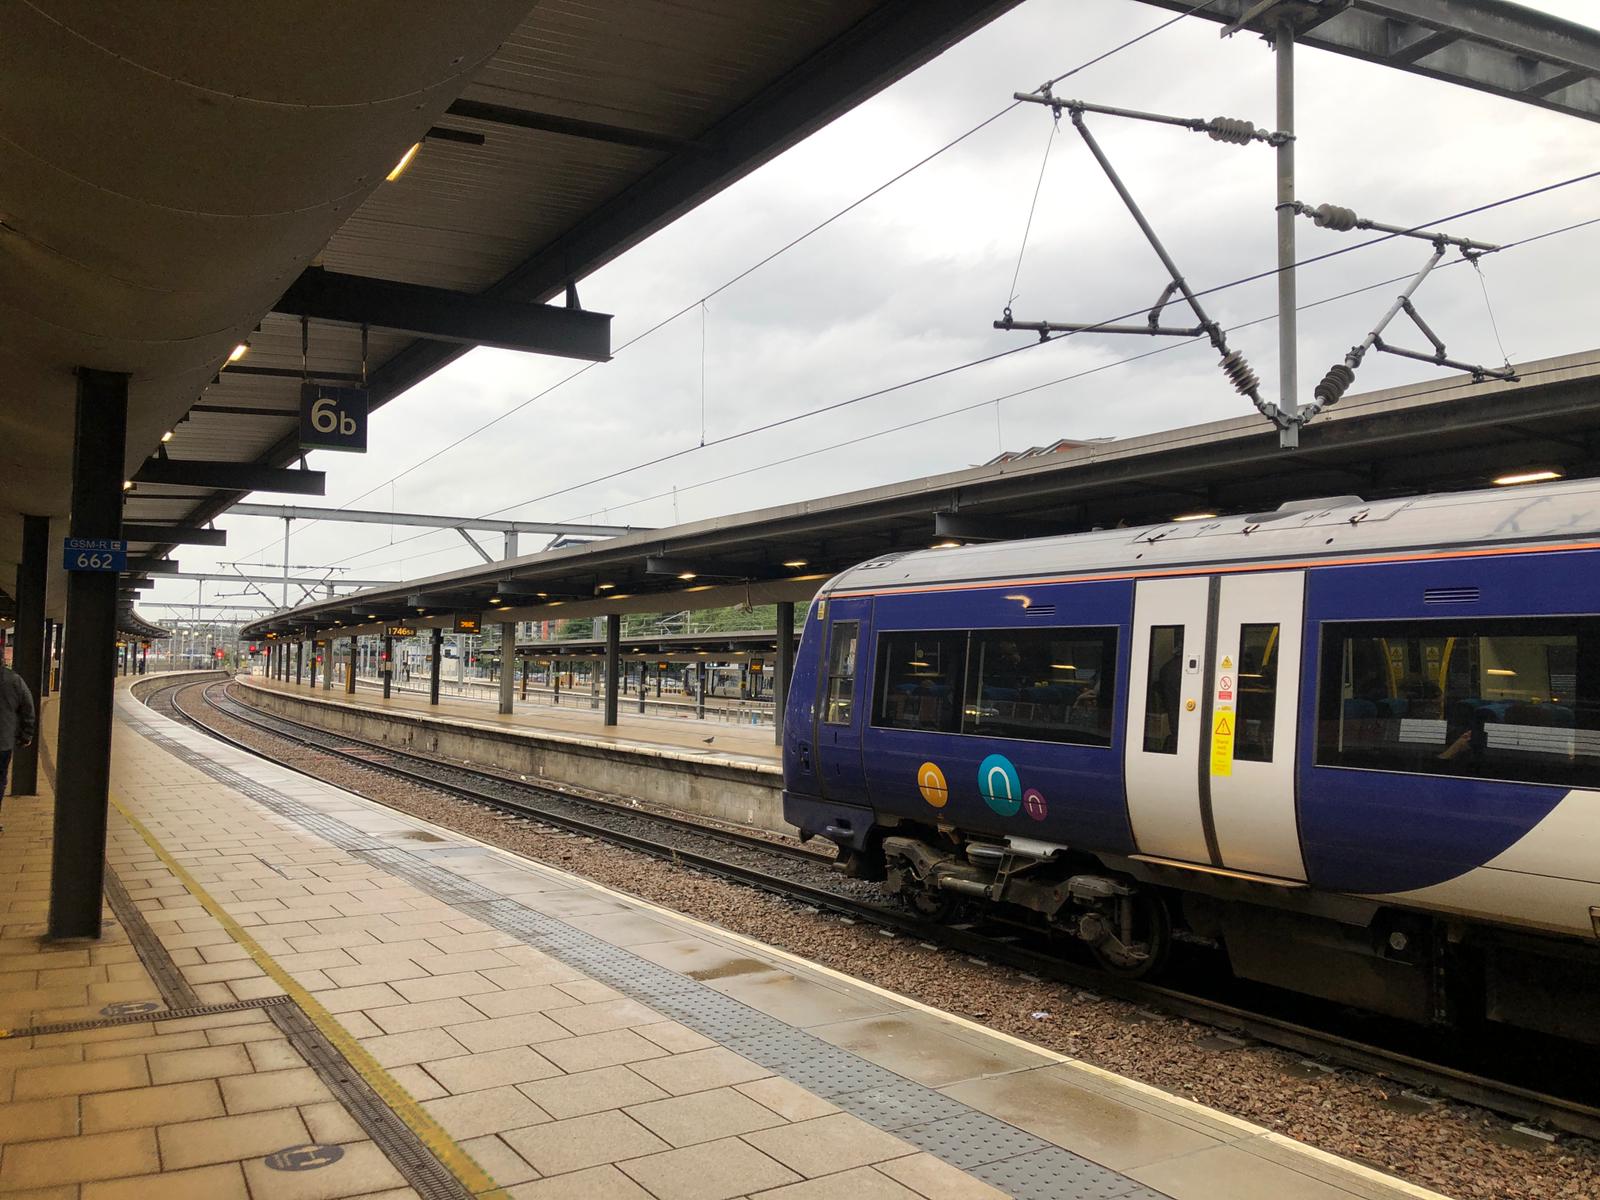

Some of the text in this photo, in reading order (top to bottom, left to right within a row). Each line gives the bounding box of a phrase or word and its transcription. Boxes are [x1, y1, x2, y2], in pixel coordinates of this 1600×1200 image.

[311, 398, 356, 436] 6b
[70, 539, 107, 549] GSM-R
[77, 552, 113, 569] 662
